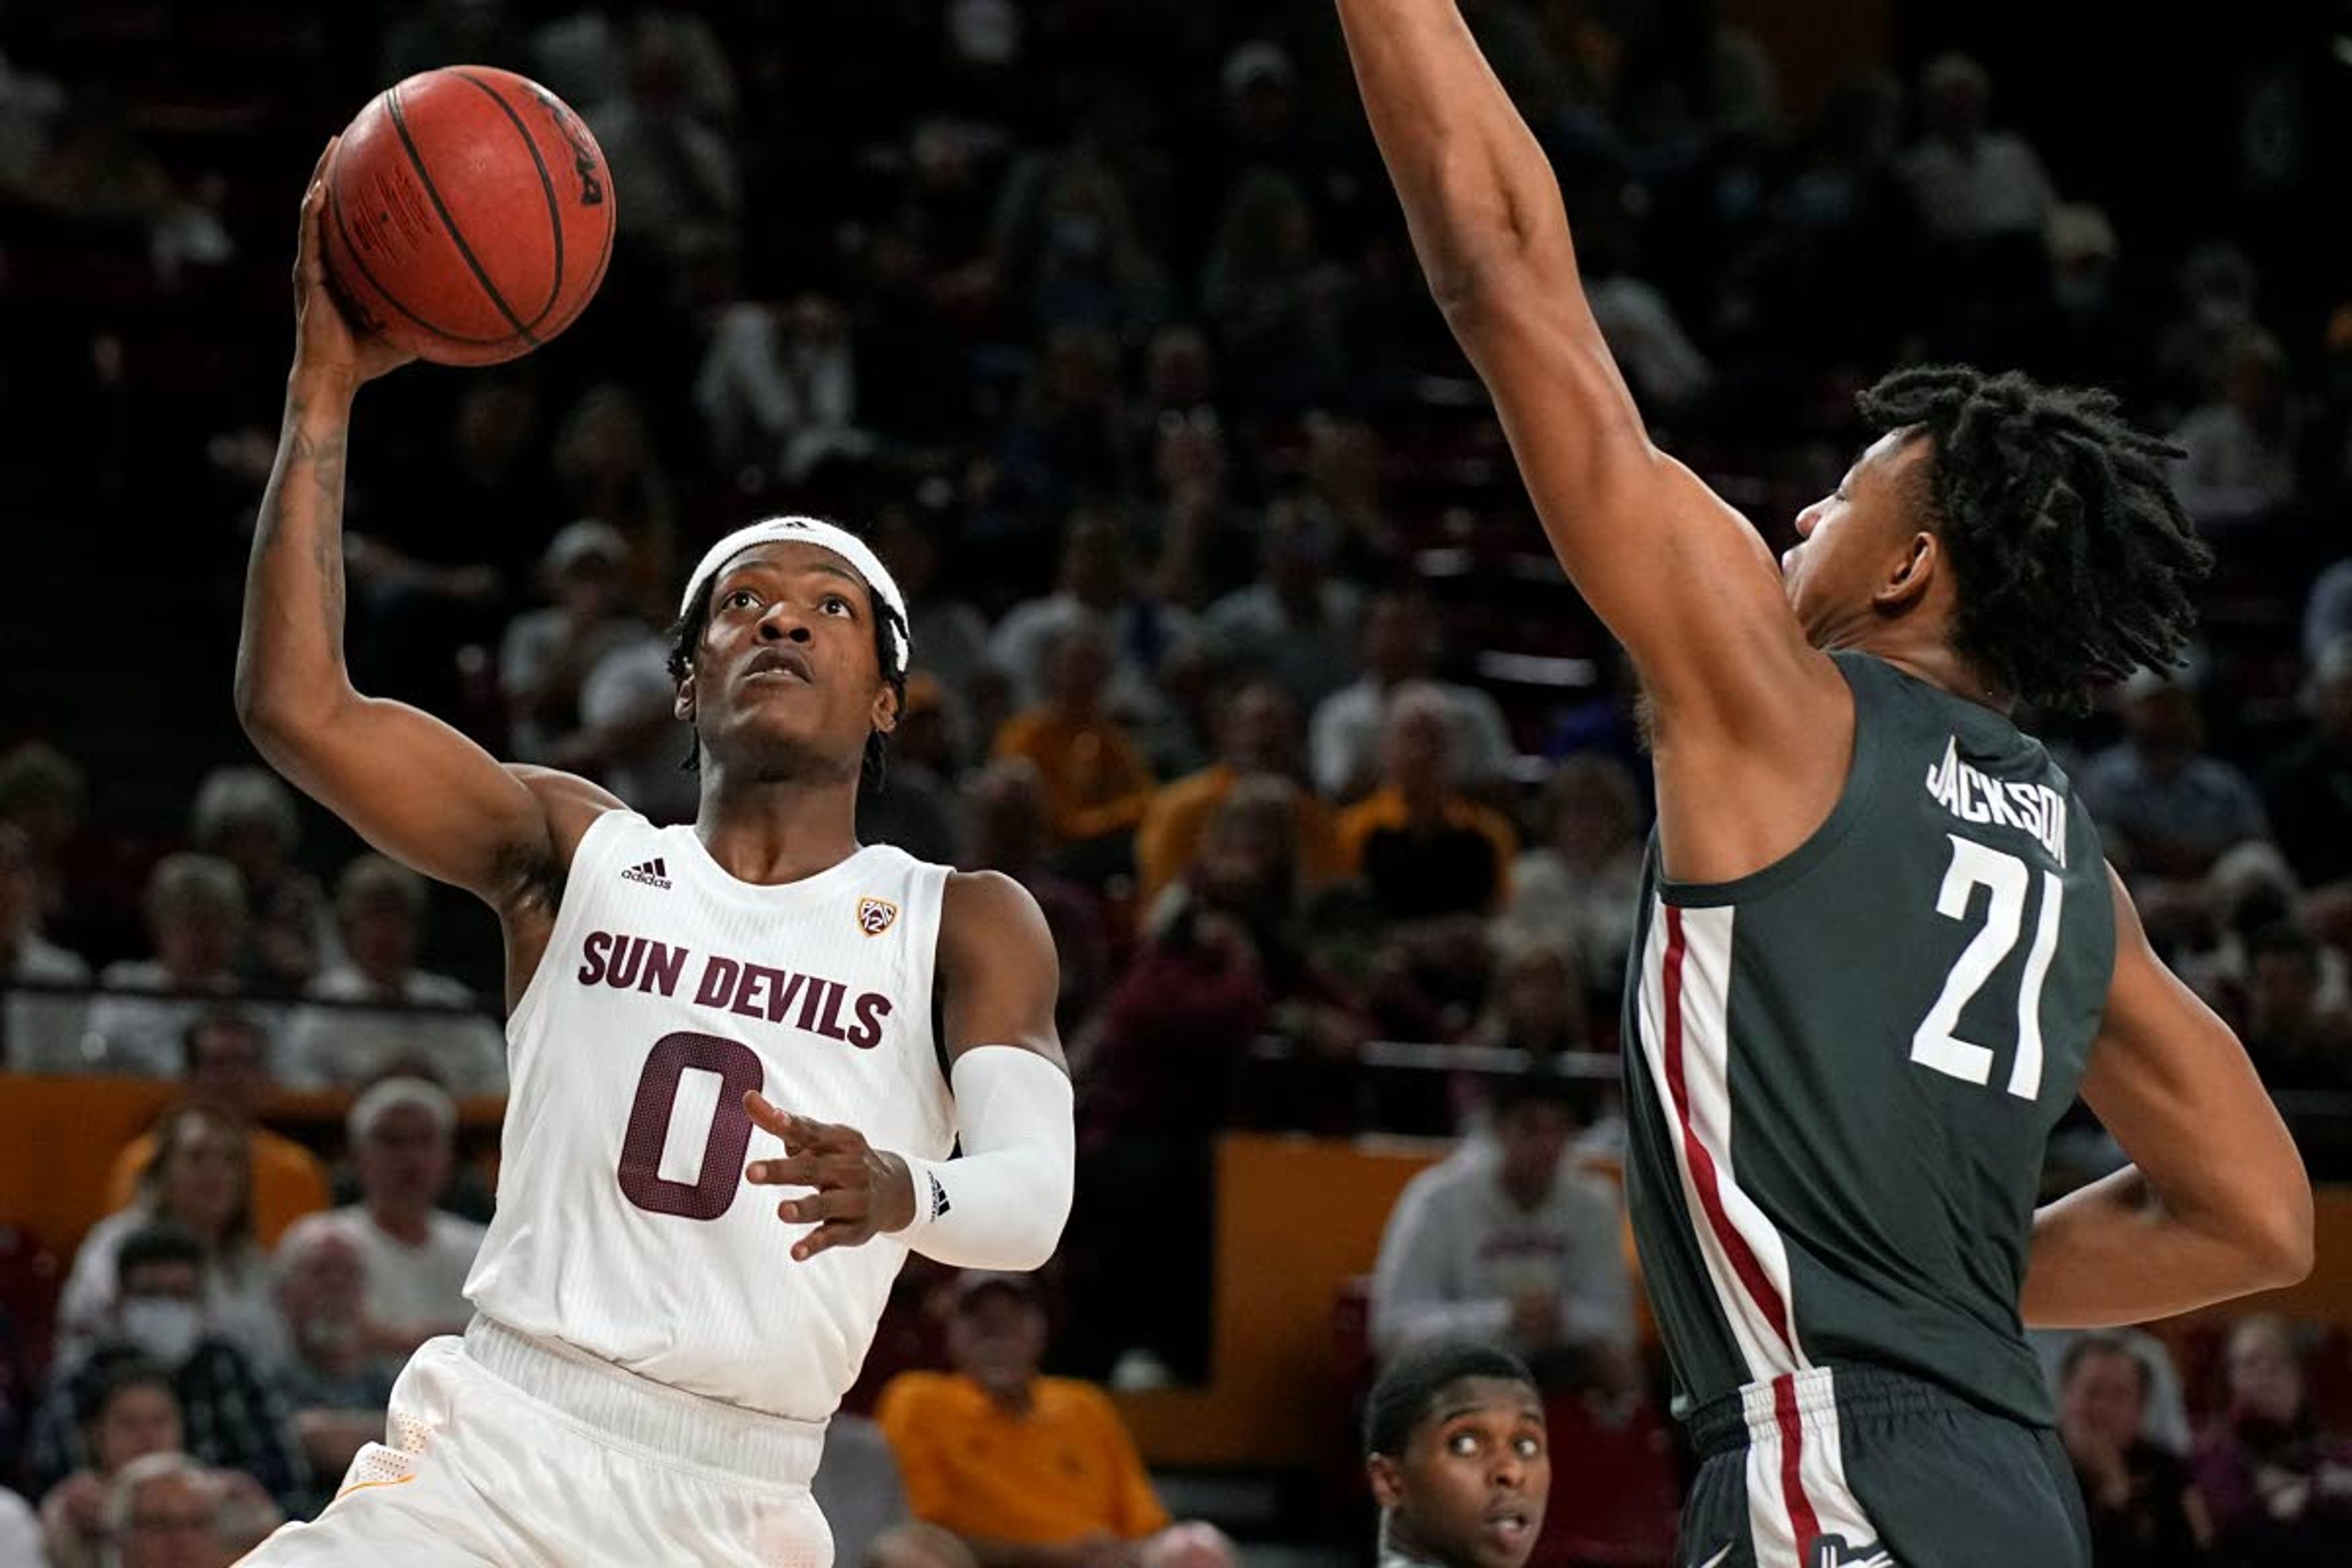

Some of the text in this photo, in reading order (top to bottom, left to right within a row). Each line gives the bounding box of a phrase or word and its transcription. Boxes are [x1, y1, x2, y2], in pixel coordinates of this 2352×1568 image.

[621, 870, 673, 890] adidas
[578, 930, 893, 1049] SUN DEVILS
[1910, 832, 2064, 1101] 21
[617, 1031, 764, 1221] 0
